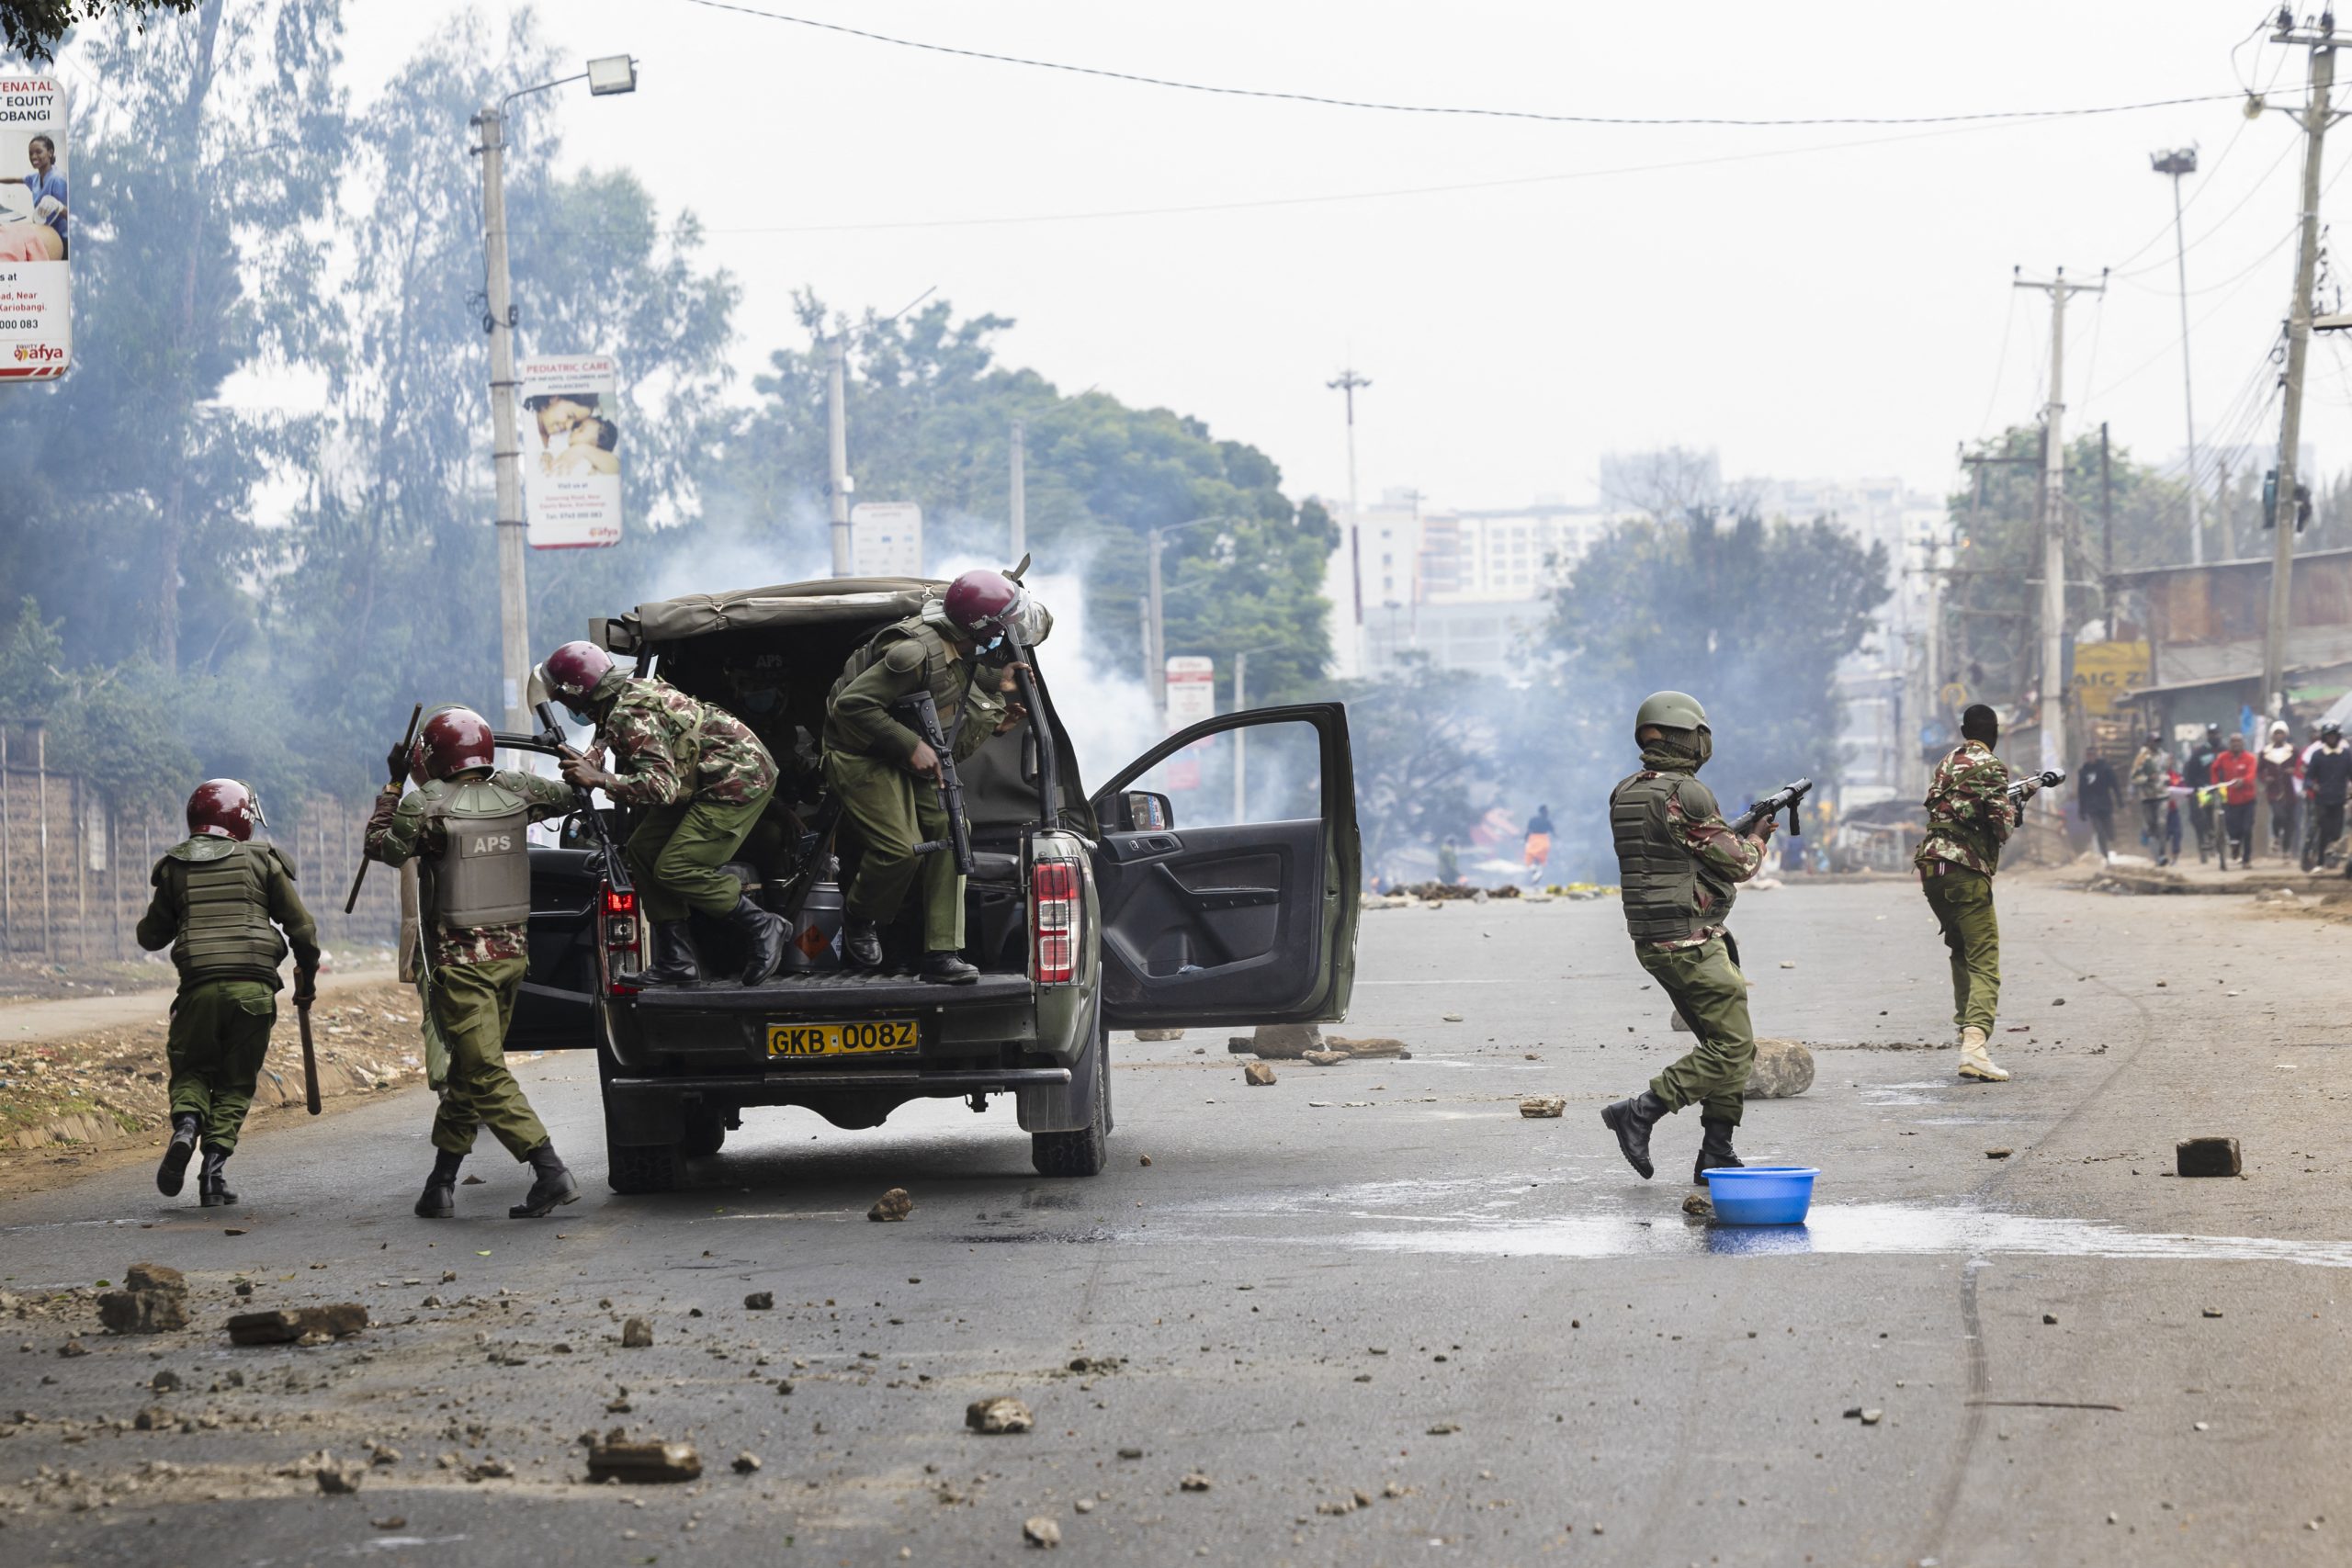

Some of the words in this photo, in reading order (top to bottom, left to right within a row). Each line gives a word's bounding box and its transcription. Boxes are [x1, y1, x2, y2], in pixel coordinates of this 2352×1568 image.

[0, 81, 53, 92] ENATAL
[6, 96, 53, 107] EQUITY
[0, 110, 50, 121] OBANGI
[8, 273, 17, 281] at
[17, 291, 38, 299] Near
[19, 319, 39, 329] 083
[28, 344, 63, 361] afya
[526, 364, 579, 374] PEDIATRIC
[582, 362, 609, 371] CARE
[473, 835, 512, 853] APS
[773, 1029, 825, 1054] GKB
[842, 1022, 912, 1049] 008Z
